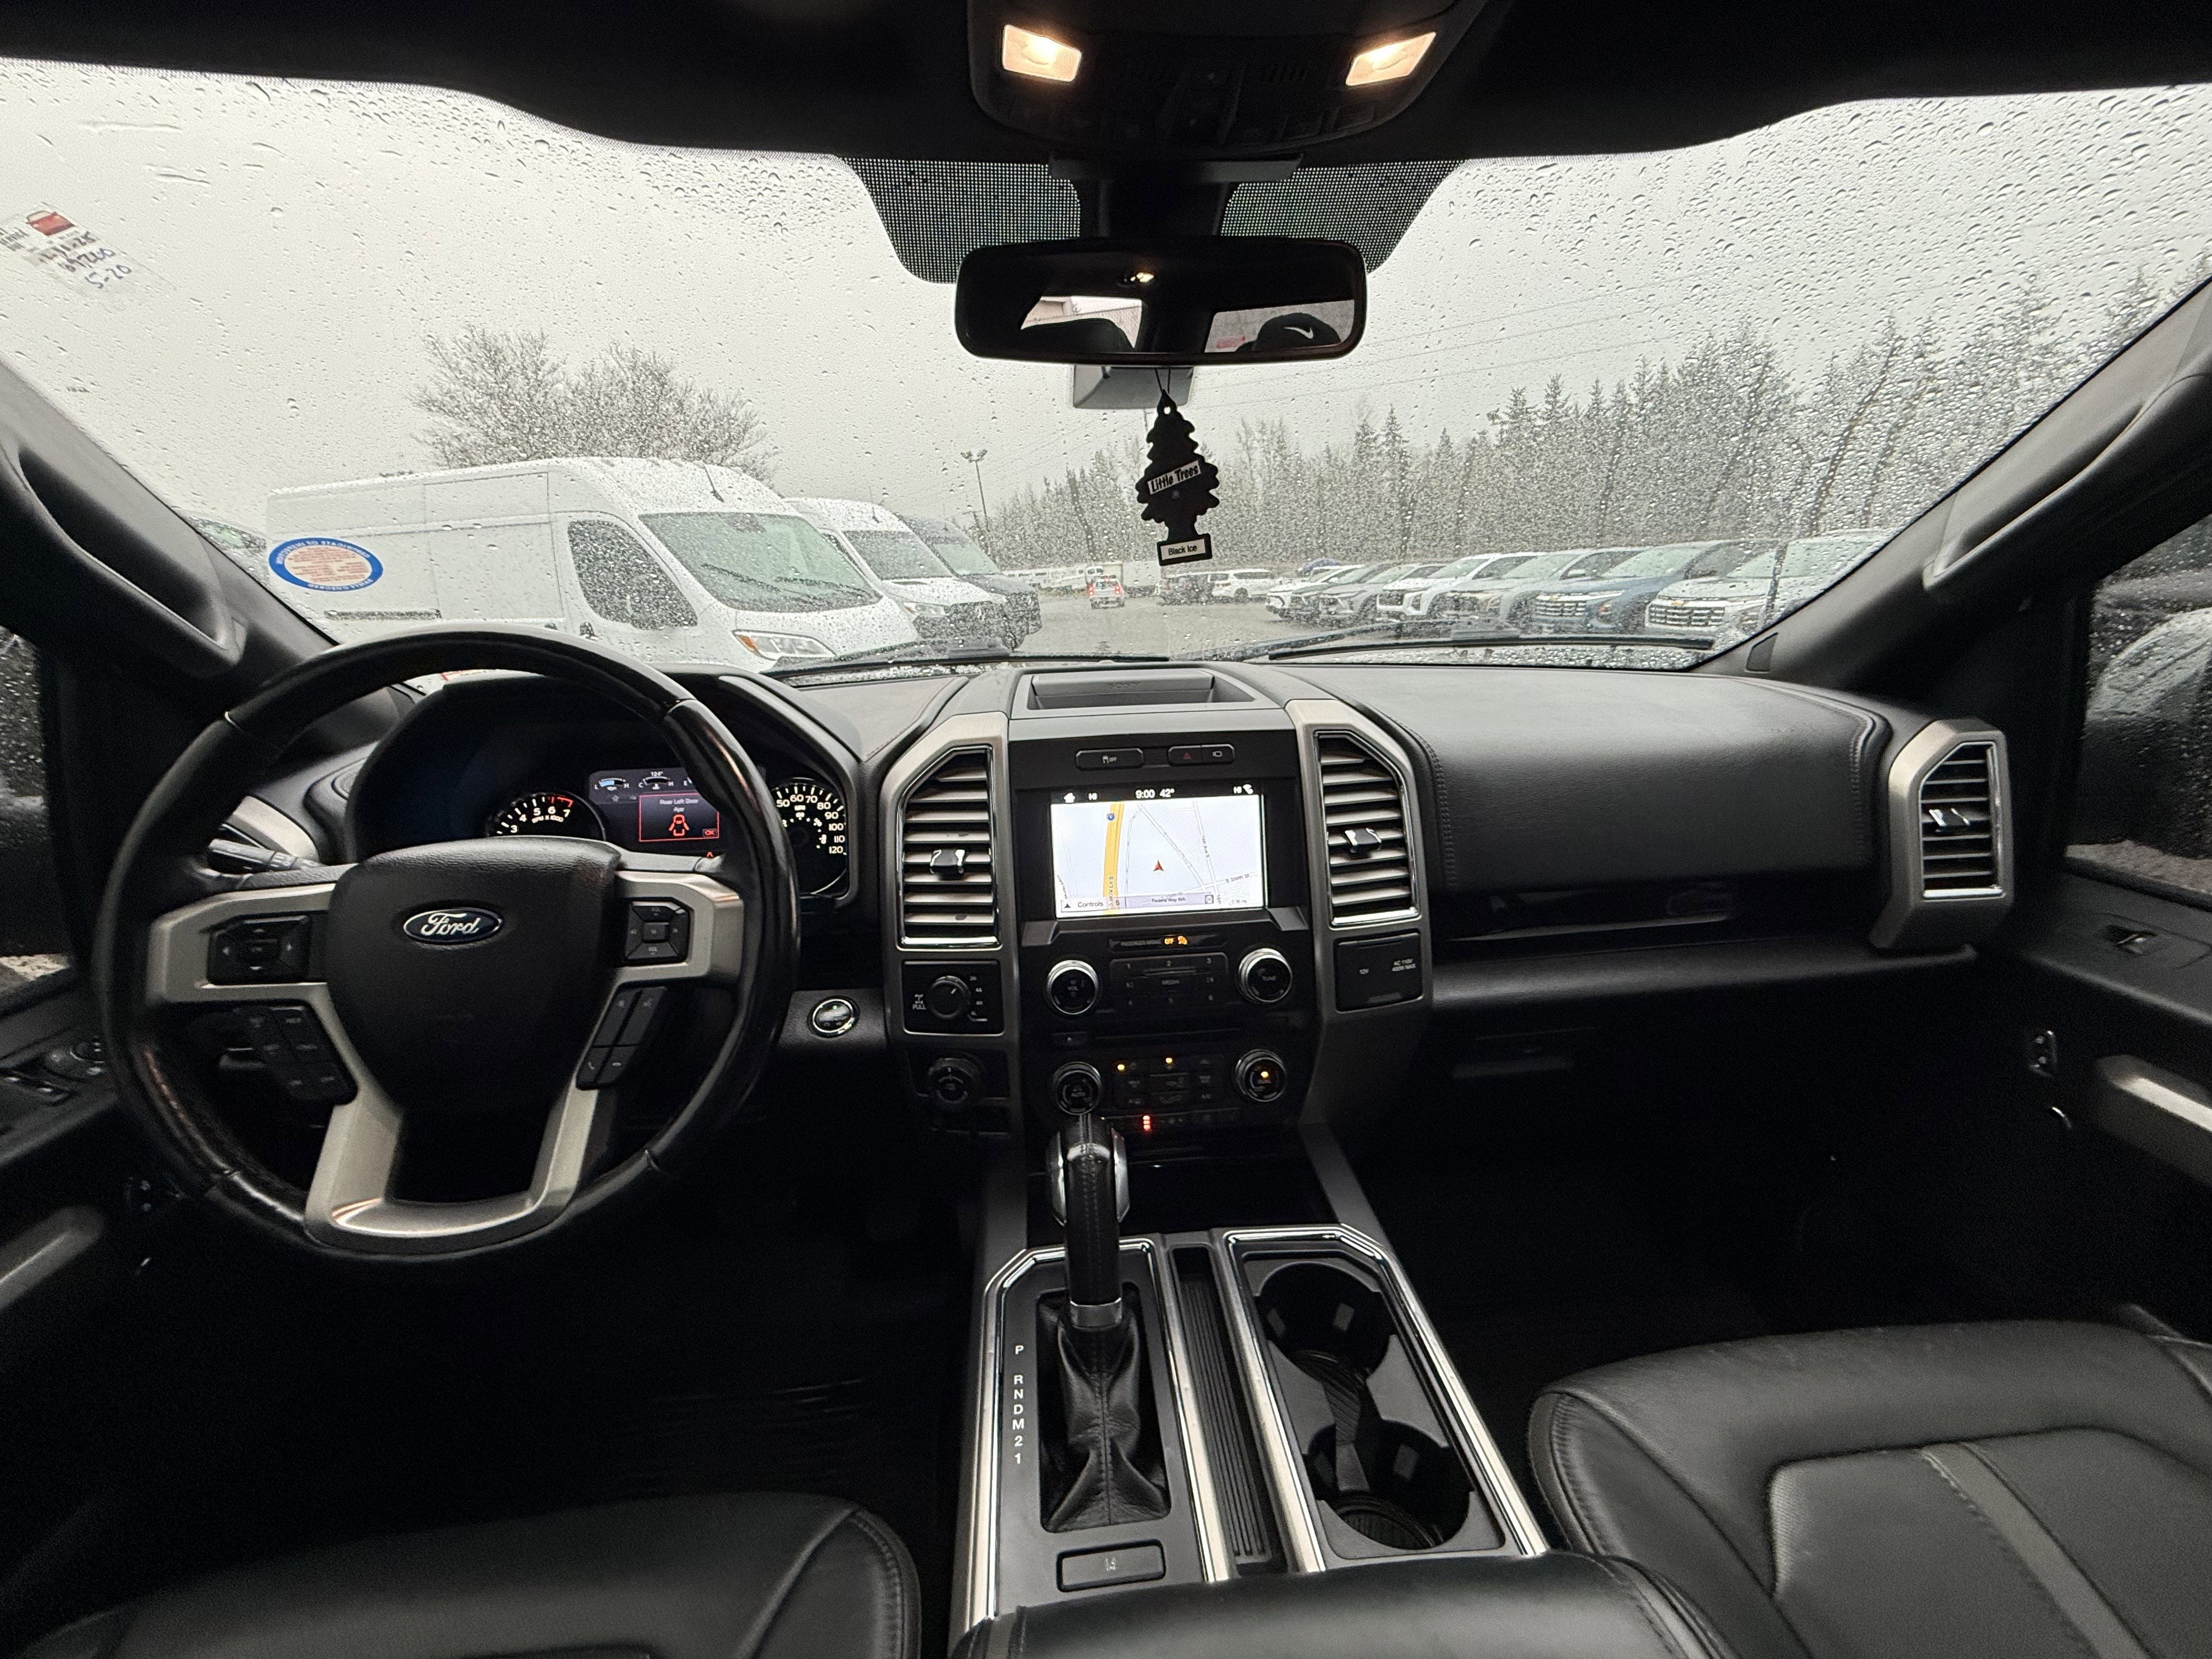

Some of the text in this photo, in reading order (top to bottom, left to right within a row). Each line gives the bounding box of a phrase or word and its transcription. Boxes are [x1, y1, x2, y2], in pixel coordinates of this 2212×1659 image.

[1152, 465, 1199, 492] Little Trees
[1168, 544, 1197, 556] Black Ice
[790, 794, 804, 802] 60
[1136, 788, 1175, 799] 9:00 42°
[776, 799, 790, 808] 50
[805, 795, 818, 803] 70
[548, 806, 556, 815] 6
[817, 802, 831, 810] 80
[533, 808, 541, 816] 5
[563, 809, 570, 817] 7
[825, 811, 839, 820] 90
[519, 814, 527, 822] 4
[510, 825, 518, 833] 3
[828, 823, 844, 831] 100
[834, 835, 845, 843] 110
[828, 845, 844, 854] 120
[421, 913, 482, 936] Ford
[1015, 1345, 1024, 1355] P
[1014, 1375, 1024, 1385] R
[1014, 1389, 1024, 1400] N
[1013, 1404, 1024, 1415] D
[1012, 1418, 1025, 1430] M
[1014, 1435, 1023, 1446] 2
[1014, 1453, 1021, 1464] 1
